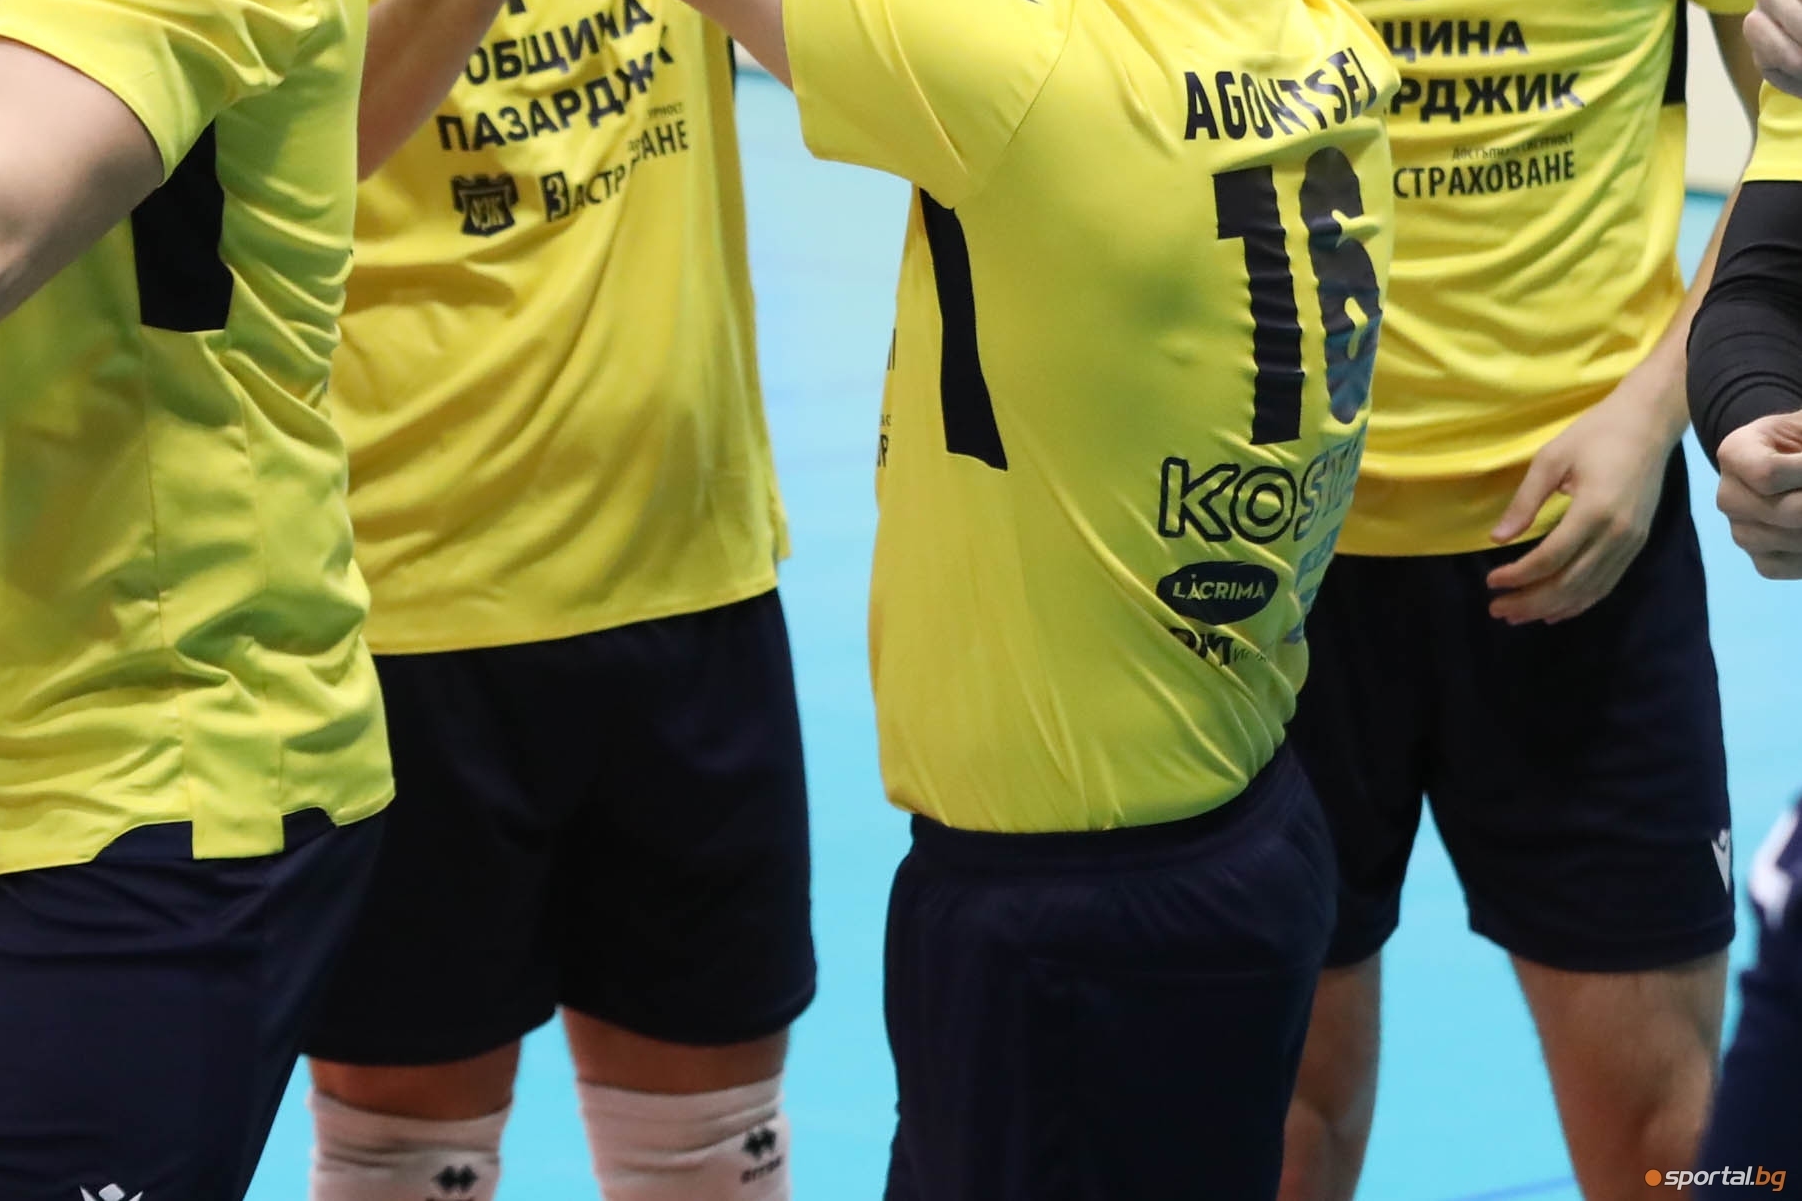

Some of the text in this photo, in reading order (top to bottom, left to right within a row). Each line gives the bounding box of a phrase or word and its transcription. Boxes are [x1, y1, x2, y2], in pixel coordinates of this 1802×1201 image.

[1390, 72, 1586, 123] РДЖИК
[1392, 150, 1575, 199] СТРАХОВАНЕ
[1212, 146, 1385, 446] 16
